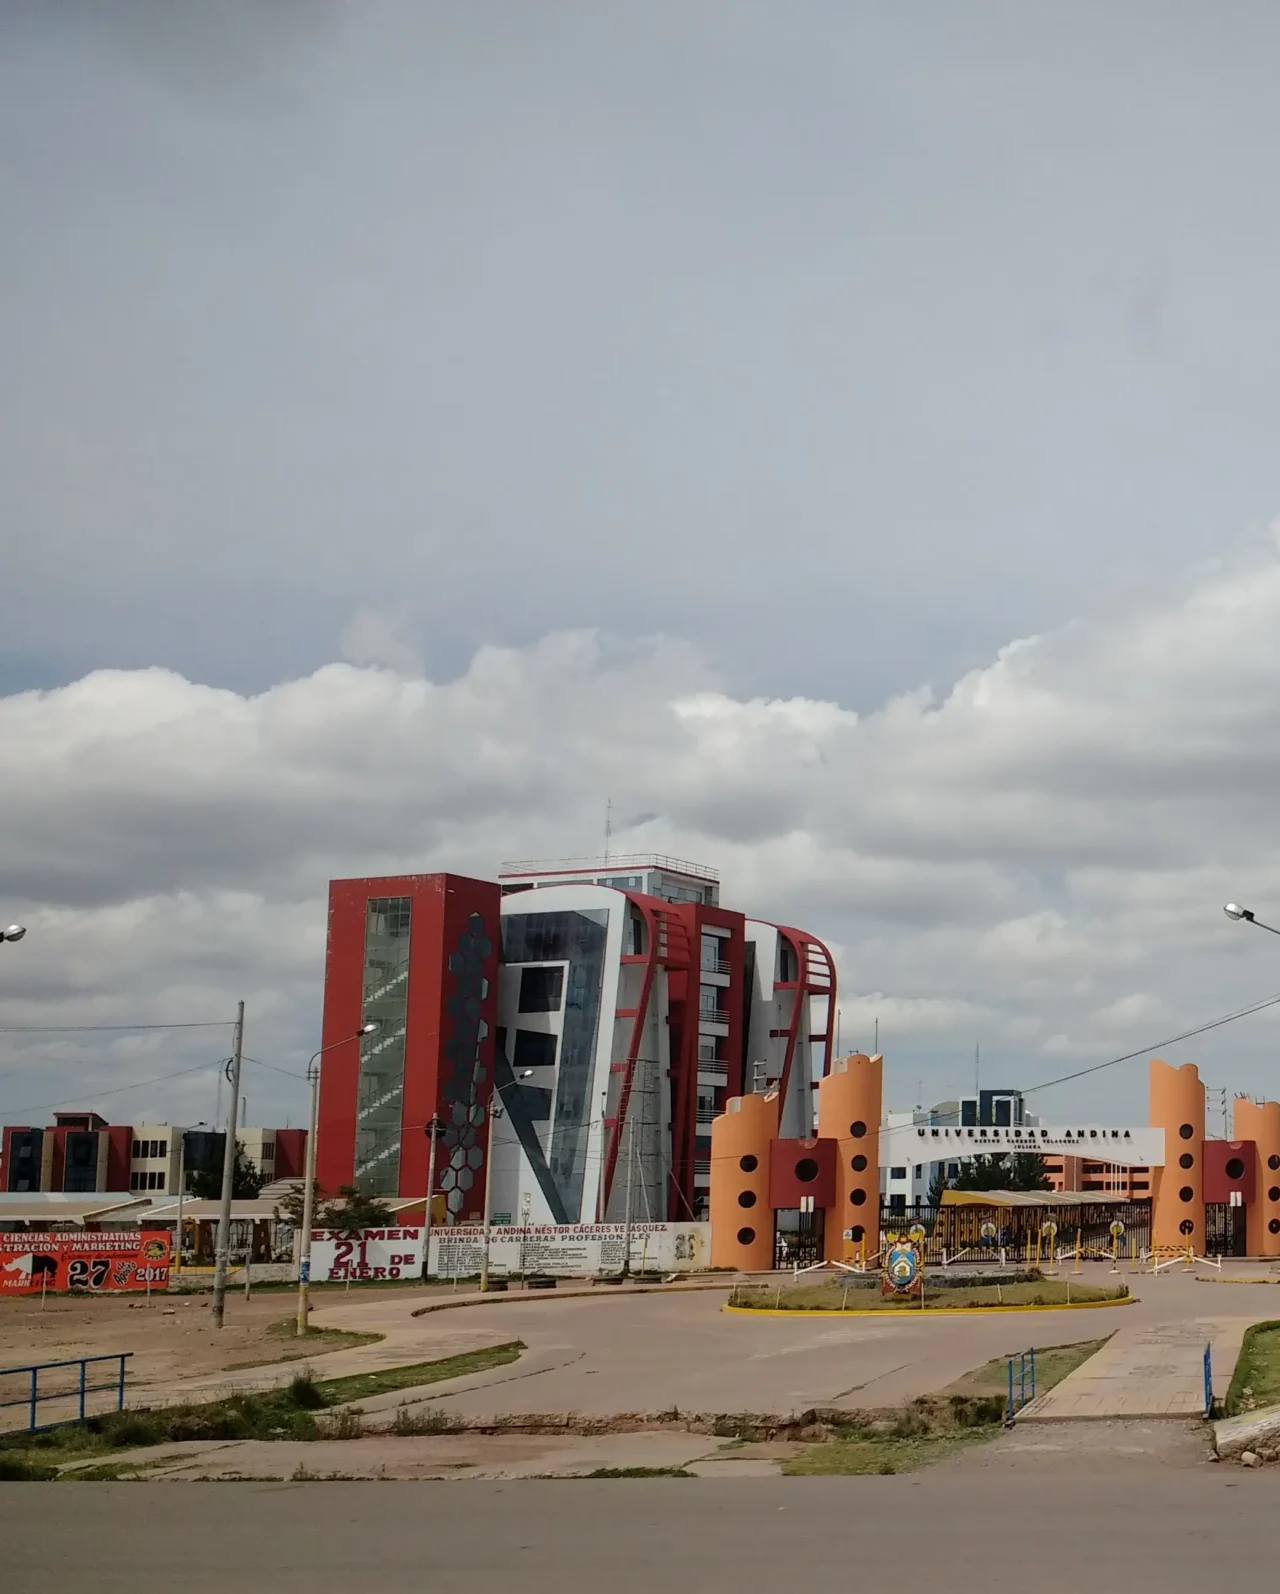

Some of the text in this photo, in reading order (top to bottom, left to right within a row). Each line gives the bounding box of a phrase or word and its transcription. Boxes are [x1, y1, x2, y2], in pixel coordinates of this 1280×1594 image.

[917, 1128, 1131, 1138] UNIVERSIDAD ANDINA
[311, 1229, 419, 1241] EXAMEN
[496, 1226, 532, 1235] ANDINA
[55, 1232, 141, 1241] ADMINISTRATIVAS
[500, 1234, 556, 1243] CARRERAS
[71, 1241, 140, 1251] MARKETING
[333, 1241, 369, 1268] 21
[389, 1254, 416, 1265] DE
[67, 1258, 112, 1289] 27
[136, 1267, 168, 1282] 2017
[328, 1267, 401, 1280] ENERO
